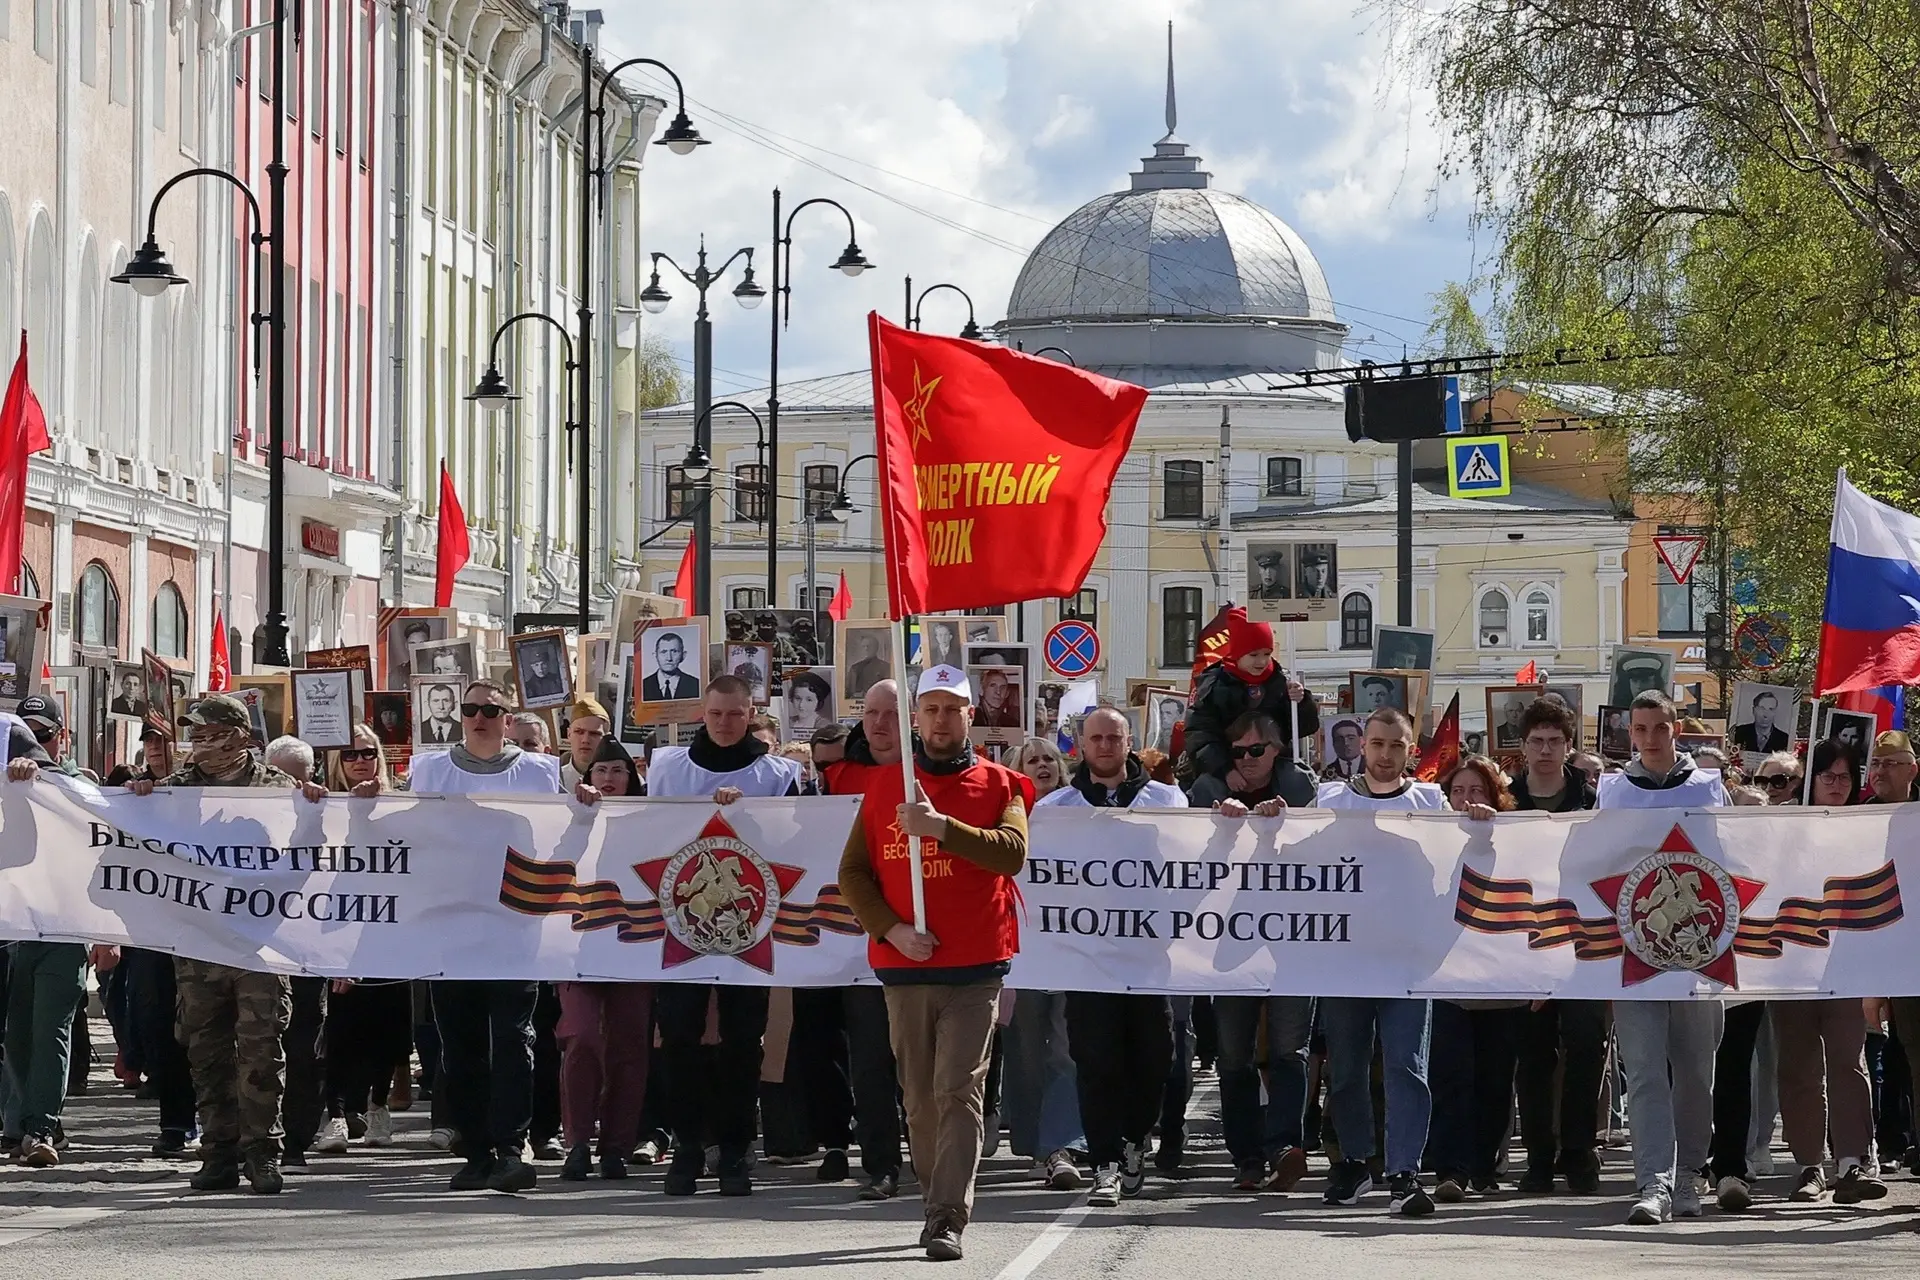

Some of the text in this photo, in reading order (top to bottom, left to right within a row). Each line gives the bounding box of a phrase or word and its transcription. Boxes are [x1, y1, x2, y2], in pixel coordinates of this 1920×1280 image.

[913, 454, 1062, 511] СМЕРТНЫЙ
[88, 820, 412, 875] БЕССМЕРТНЫЙ
[921, 858, 953, 878] ОЛК
[1027, 856, 1364, 893] БЕССМЕРТНЫЙ
[100, 864, 399, 924] ПОЛК РОССИИ
[659, 837, 780, 920] БЕССМЕРТНЫЙ ПОЛК РОССИИ
[1618, 852, 1739, 934] БЕССМЕРТНЫЙ ПОЛК РОССИИ
[1039, 904, 1351, 942] ПОЛК РОССИИ
